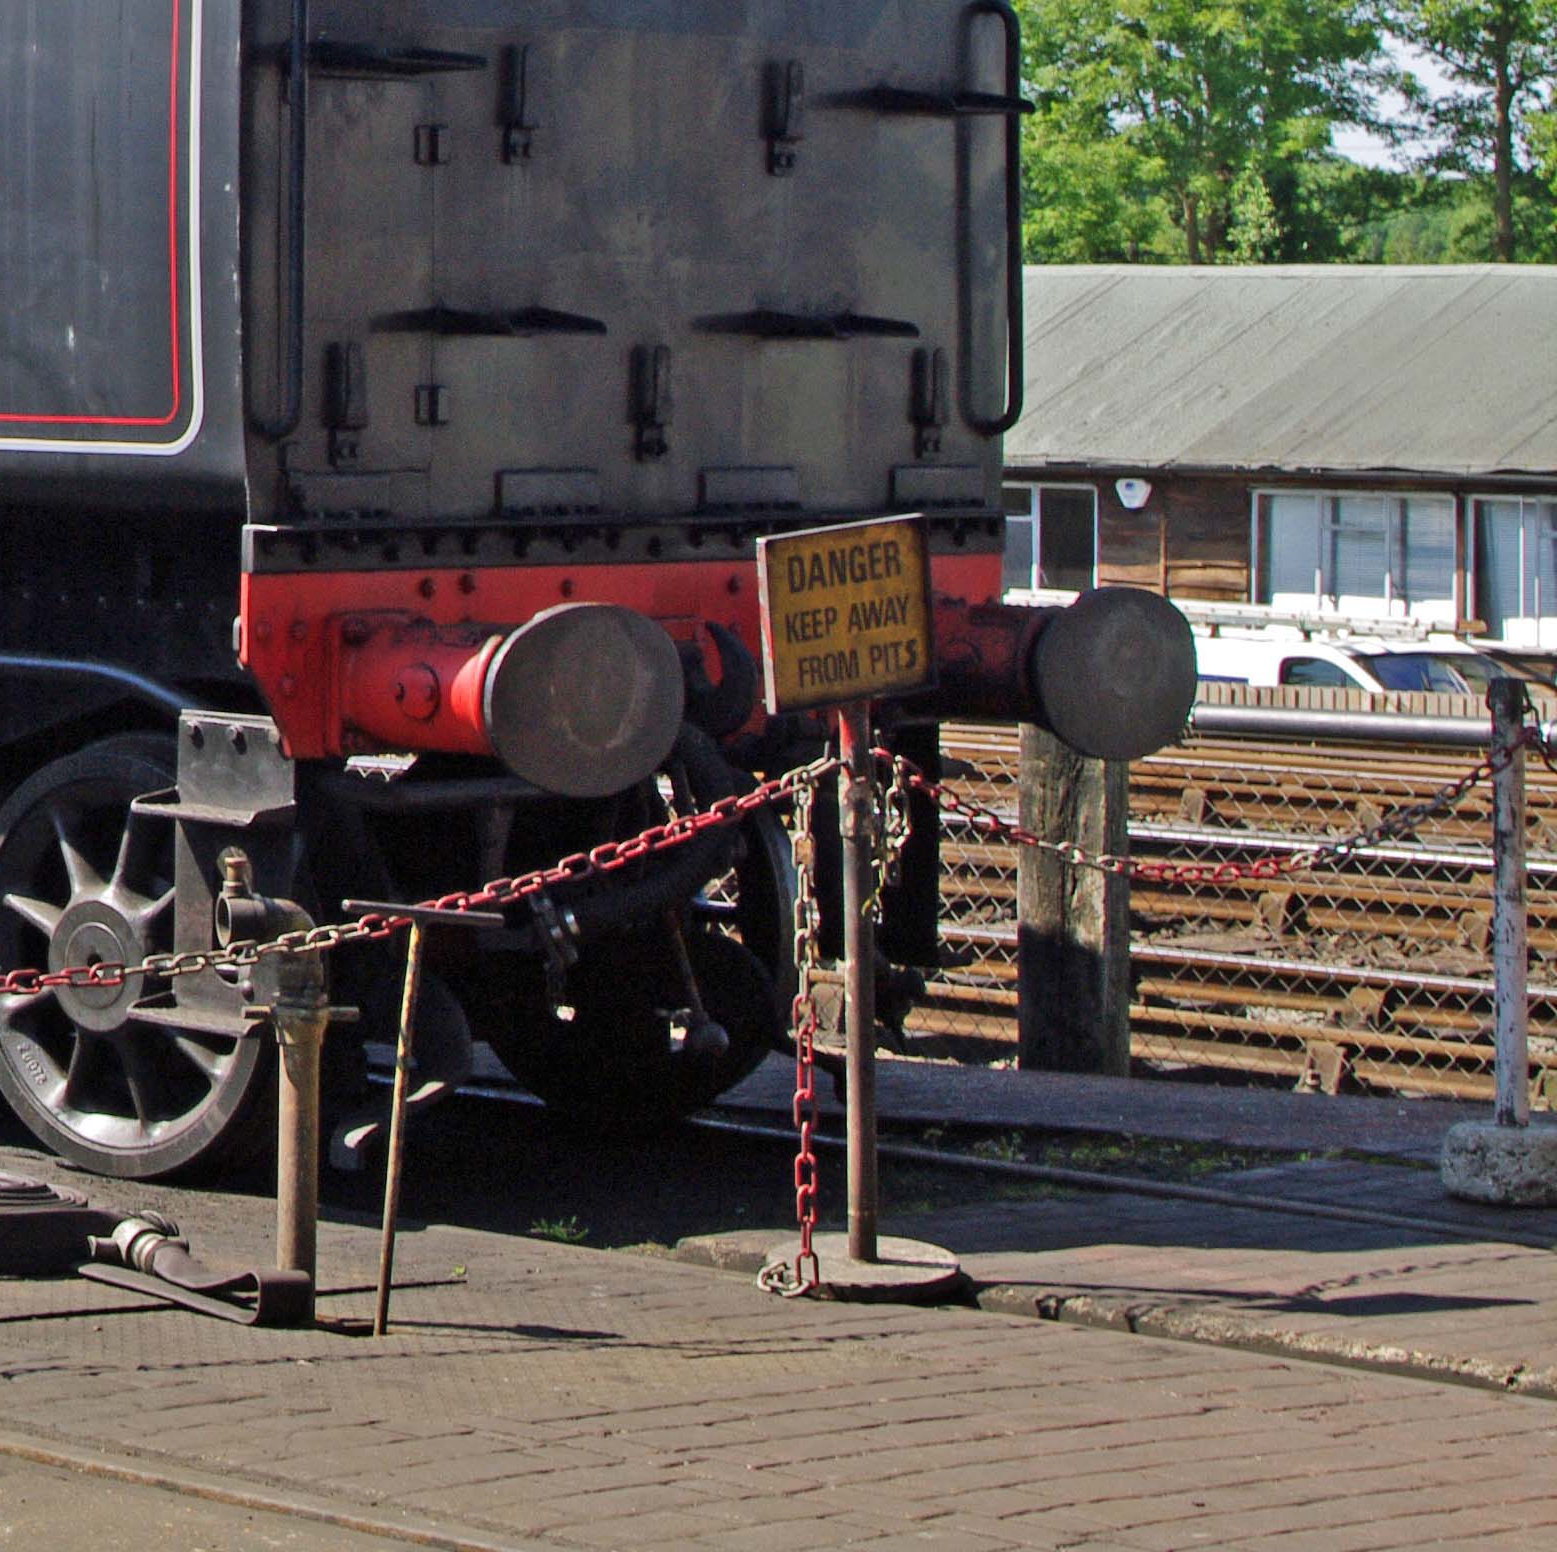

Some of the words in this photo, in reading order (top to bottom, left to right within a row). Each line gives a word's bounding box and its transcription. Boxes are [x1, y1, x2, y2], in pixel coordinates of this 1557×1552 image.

[788, 539, 902, 594] DANGER
[786, 606, 838, 644] KEEP
[847, 595, 910, 634] AWAY
[797, 649, 860, 689] FROM
[870, 639, 918, 676] PITS
